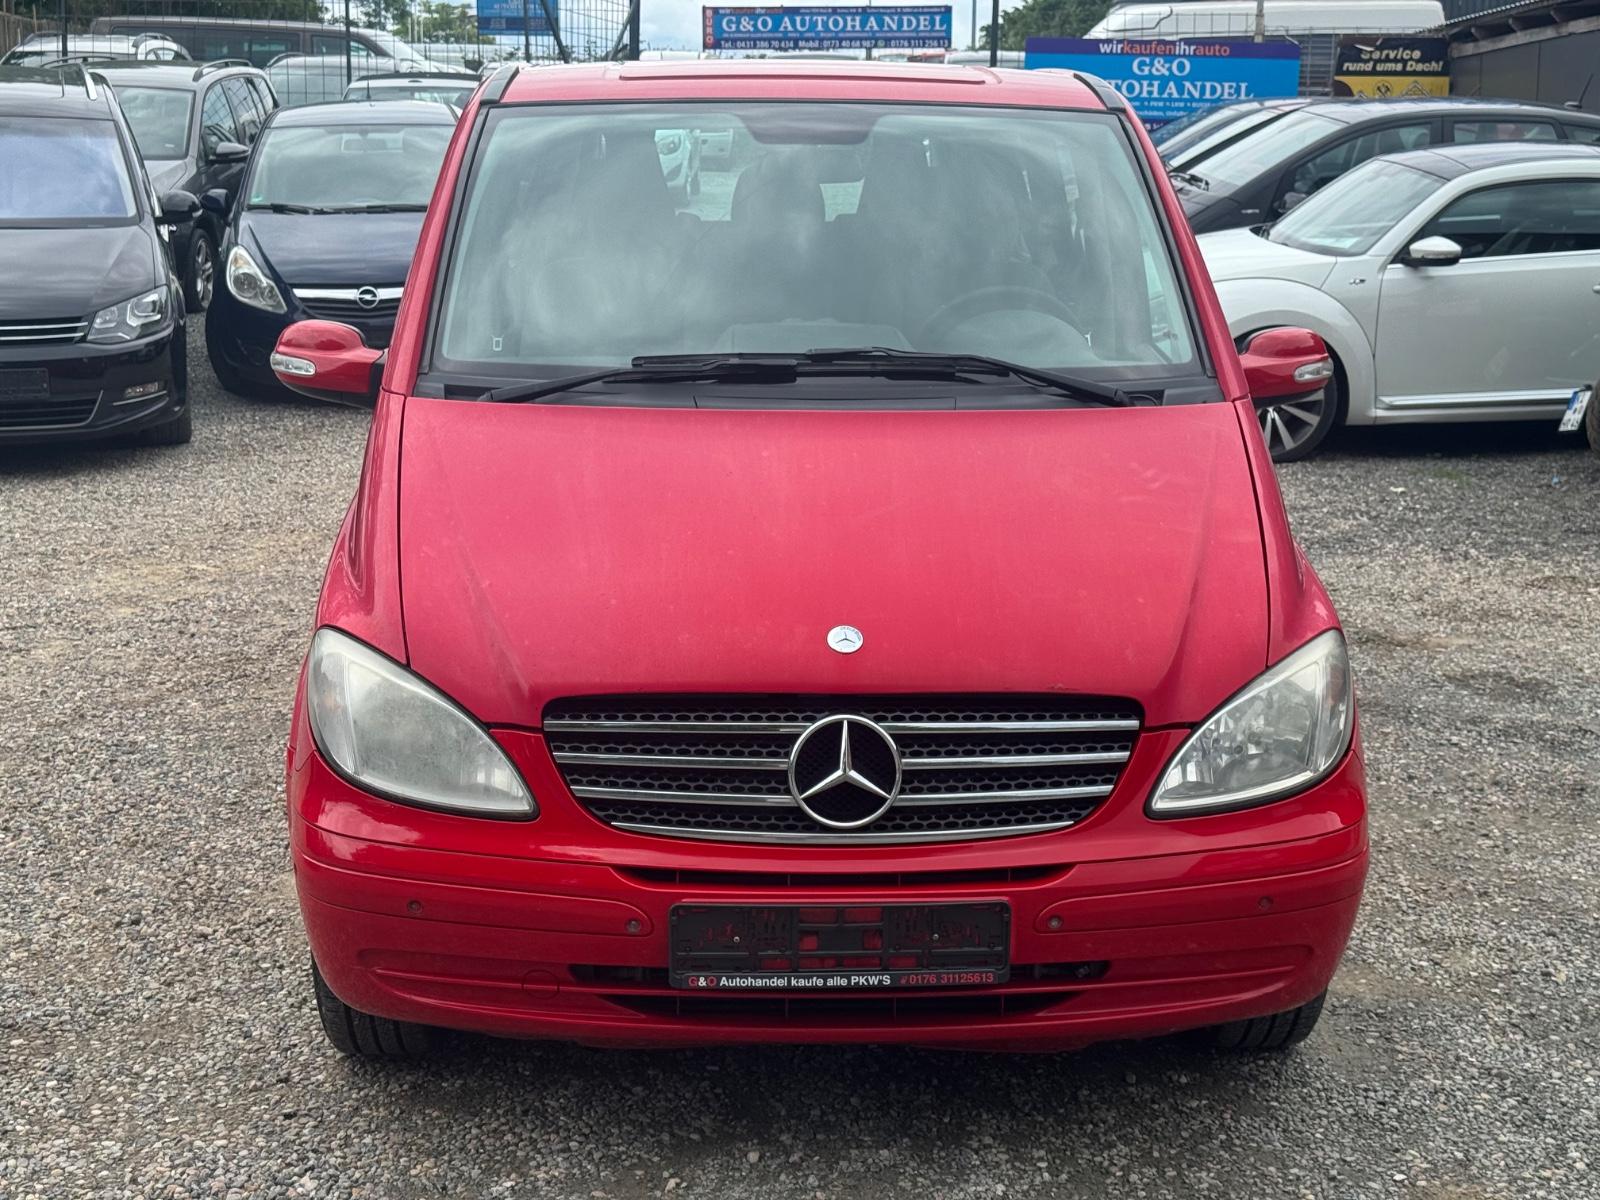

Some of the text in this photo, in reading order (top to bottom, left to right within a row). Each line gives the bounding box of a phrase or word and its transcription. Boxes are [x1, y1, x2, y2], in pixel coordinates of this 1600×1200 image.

[722, 15, 947, 32] G&O AUTOHANDEL
[1099, 40, 1231, 57] wirkaufenihrauto
[1361, 48, 1421, 59] Service
[1132, 57, 1191, 76] G&O
[1342, 61, 1443, 72] rund ums Dach!
[1106, 80, 1254, 100] TOHANDEL
[688, 972, 994, 987] G&O Autohandel kaufe alle PKW'S 0176 31125613
